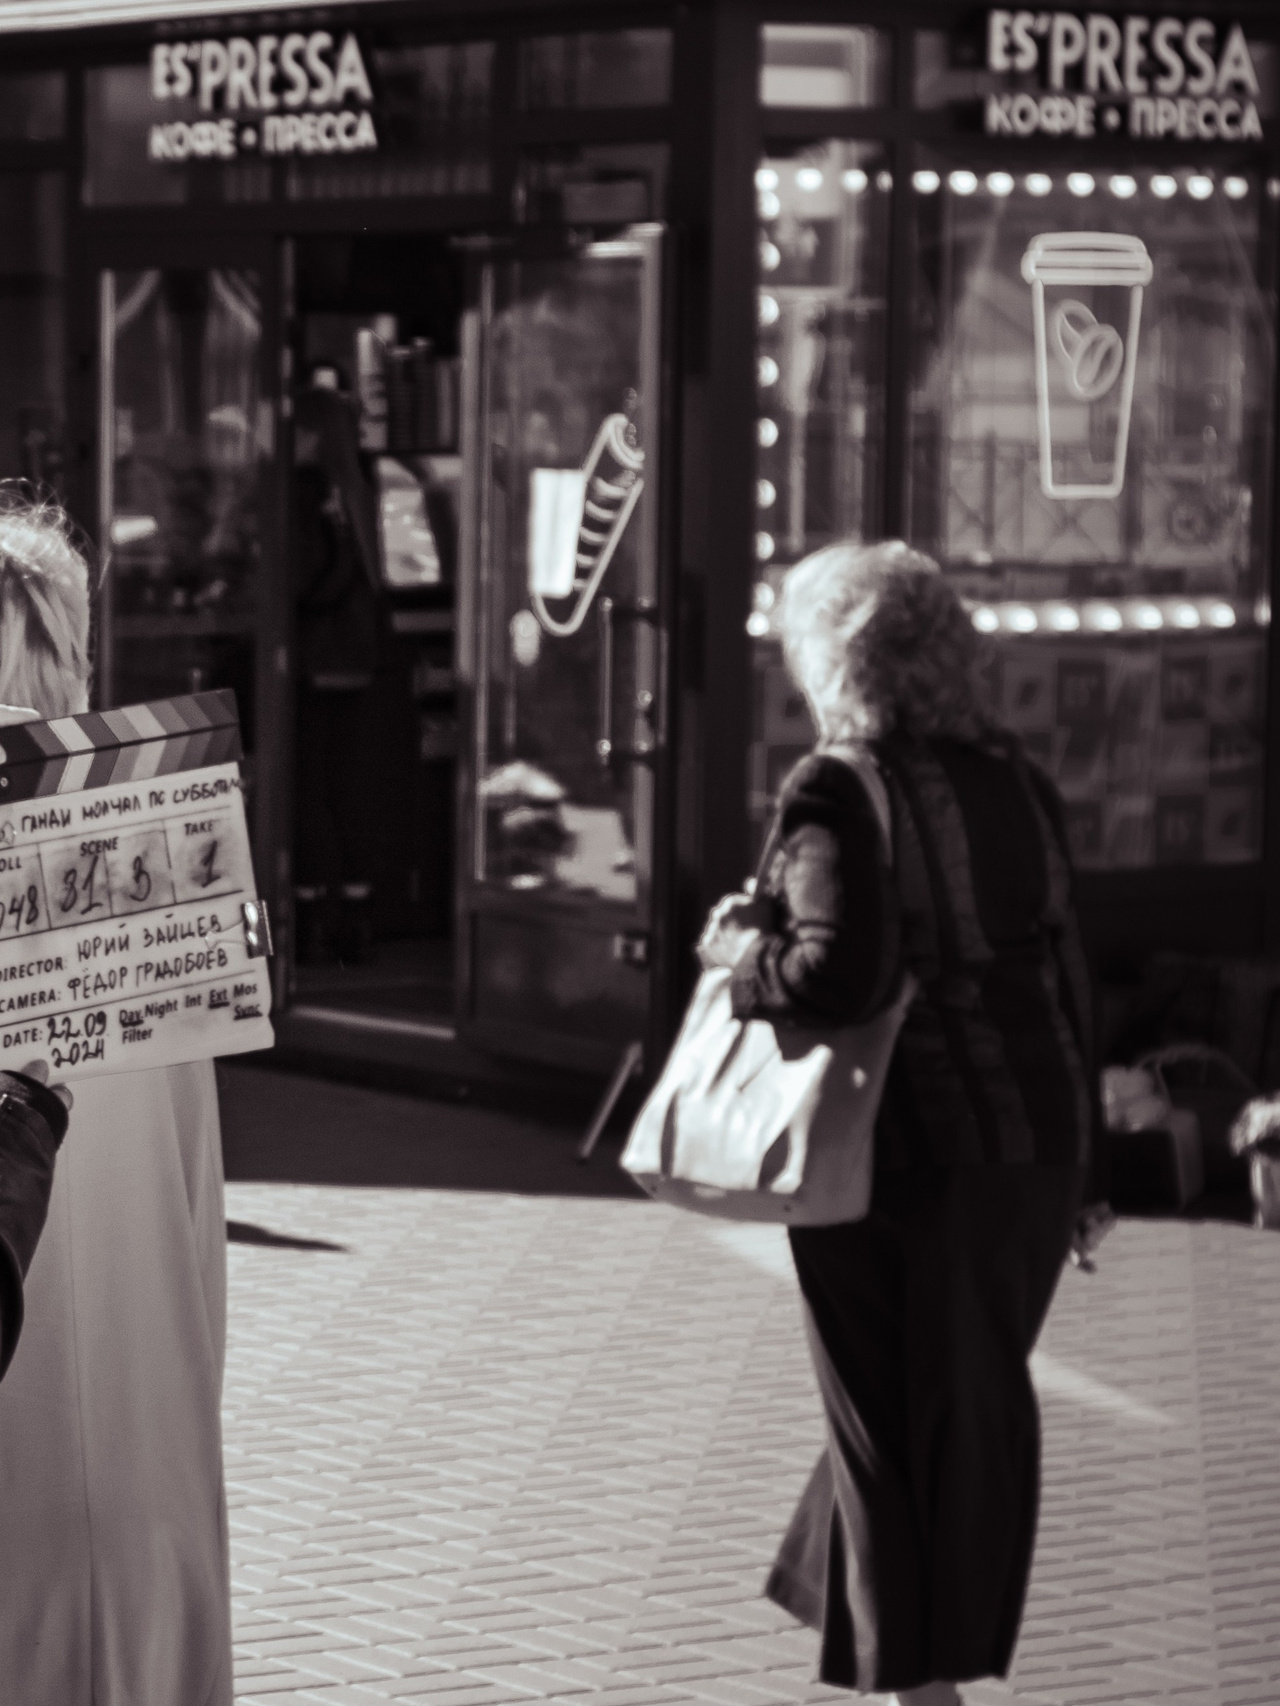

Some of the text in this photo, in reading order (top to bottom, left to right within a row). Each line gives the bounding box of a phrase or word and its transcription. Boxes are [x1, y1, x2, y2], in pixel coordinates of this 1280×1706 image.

[150, 110, 378, 159] КОФЕ ПРЕССА
[986, 93, 1263, 139] КОФЕ ПРЕССА
[21, 809, 71, 833] ГАНДИ
[81, 795, 142, 820] МОЛЧАЛ
[185, 821, 214, 837] TAKE
[80, 836, 119, 856] SCENE
[60, 855, 104, 915] 31
[130, 855, 151, 901] 3
[77, 914, 222, 962] ЮРИЙ ЗАЙЦЕВ
[136, 948, 228, 987] ГРАДОБОЕВ
[145, 997, 178, 1019] Night
[185, 994, 202, 1008] Int
[209, 988, 228, 1004] Ext
[233, 982, 257, 998] Mos
[2, 1028, 42, 1049] DATE:
[51, 1039, 105, 1068] 2024
[122, 1027, 152, 1044] Filter
